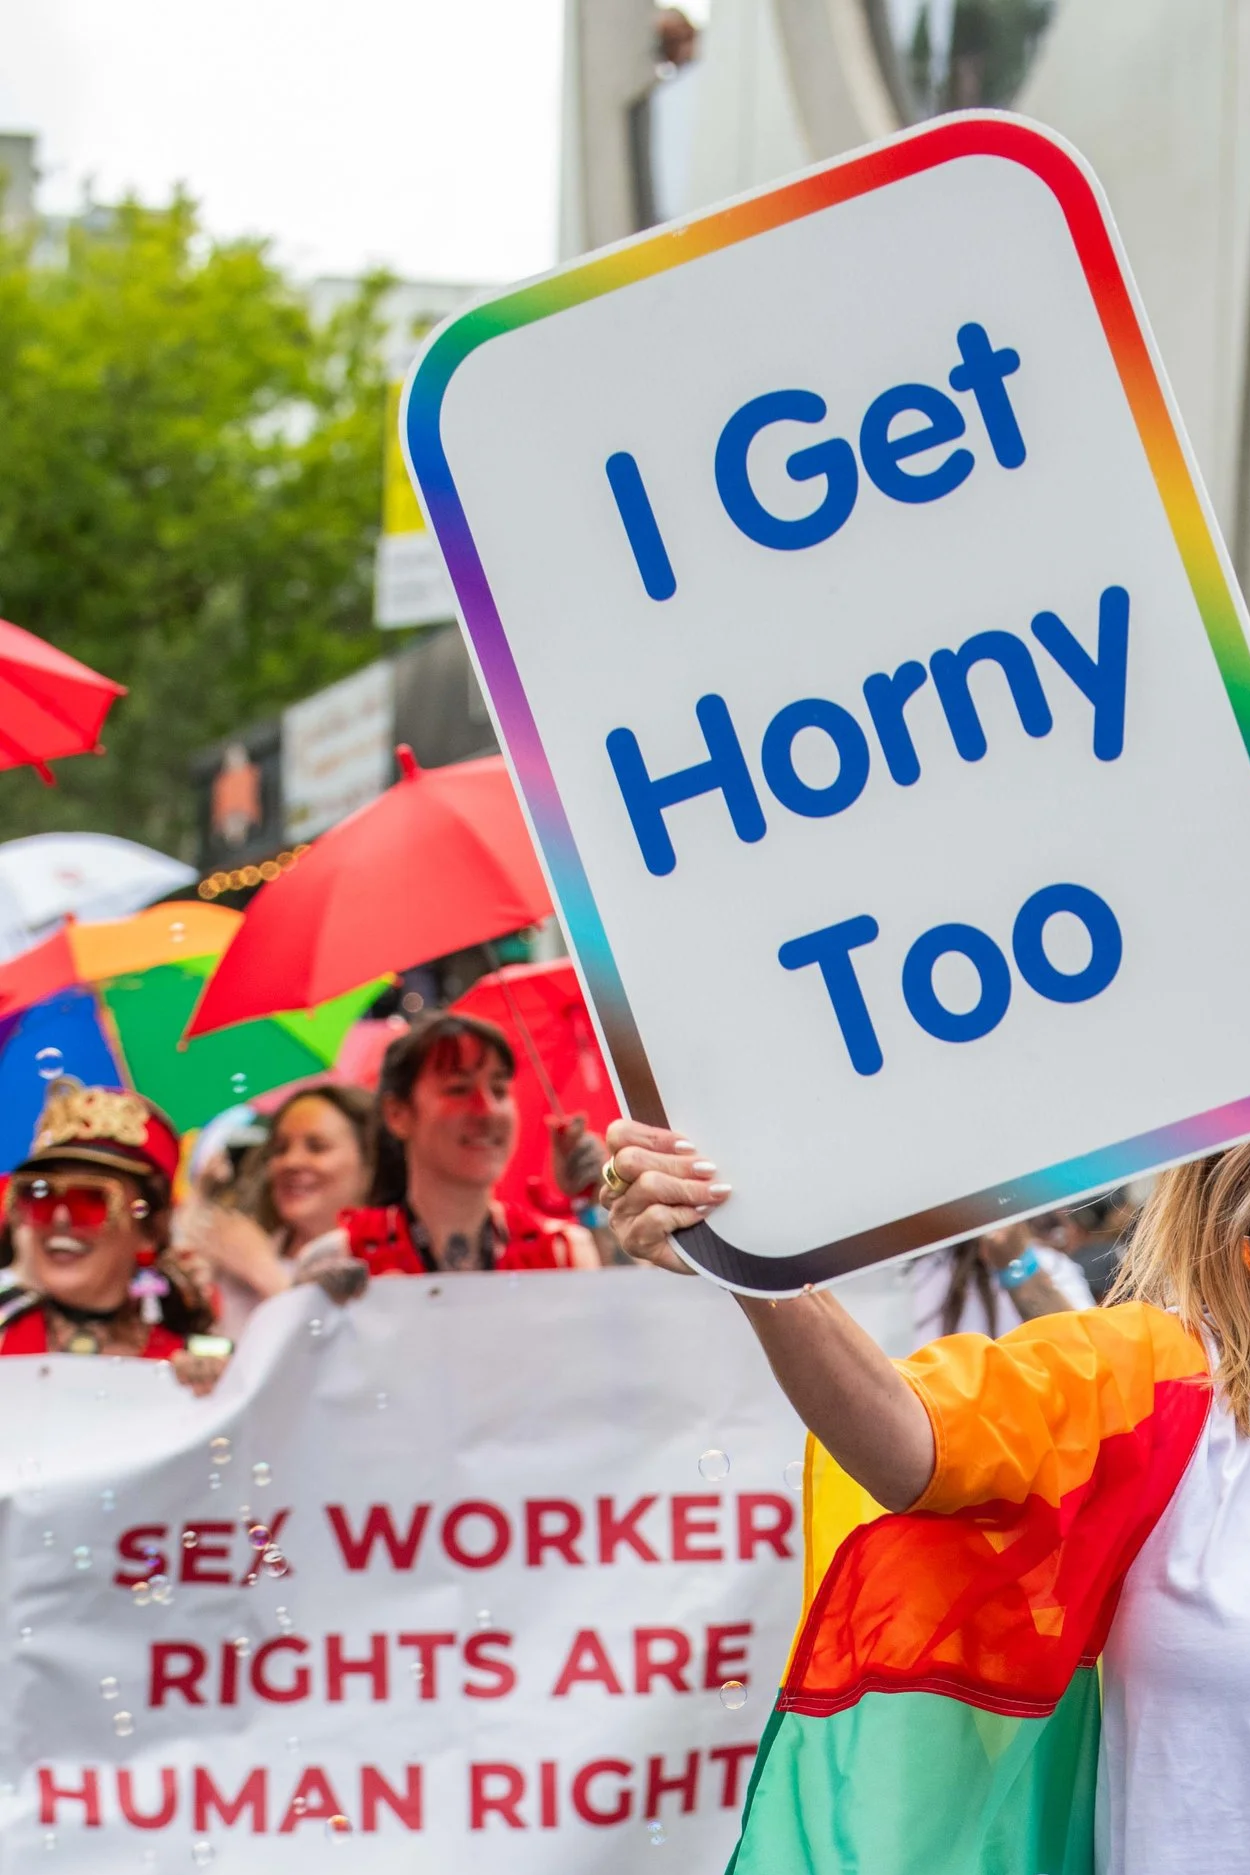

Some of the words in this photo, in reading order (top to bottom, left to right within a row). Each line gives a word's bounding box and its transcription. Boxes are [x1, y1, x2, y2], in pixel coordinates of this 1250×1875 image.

[605, 451, 677, 602] I
[715, 322, 1027, 551] Get
[605, 585, 1130, 877] Horny
[778, 883, 1122, 1077] Too
[114, 1509, 292, 1590] SEX
[327, 1492, 795, 1572] WORKER
[150, 1630, 517, 1708] RIGHTS
[553, 1622, 752, 1697] ARE
[38, 1764, 423, 1834] HUMAN
